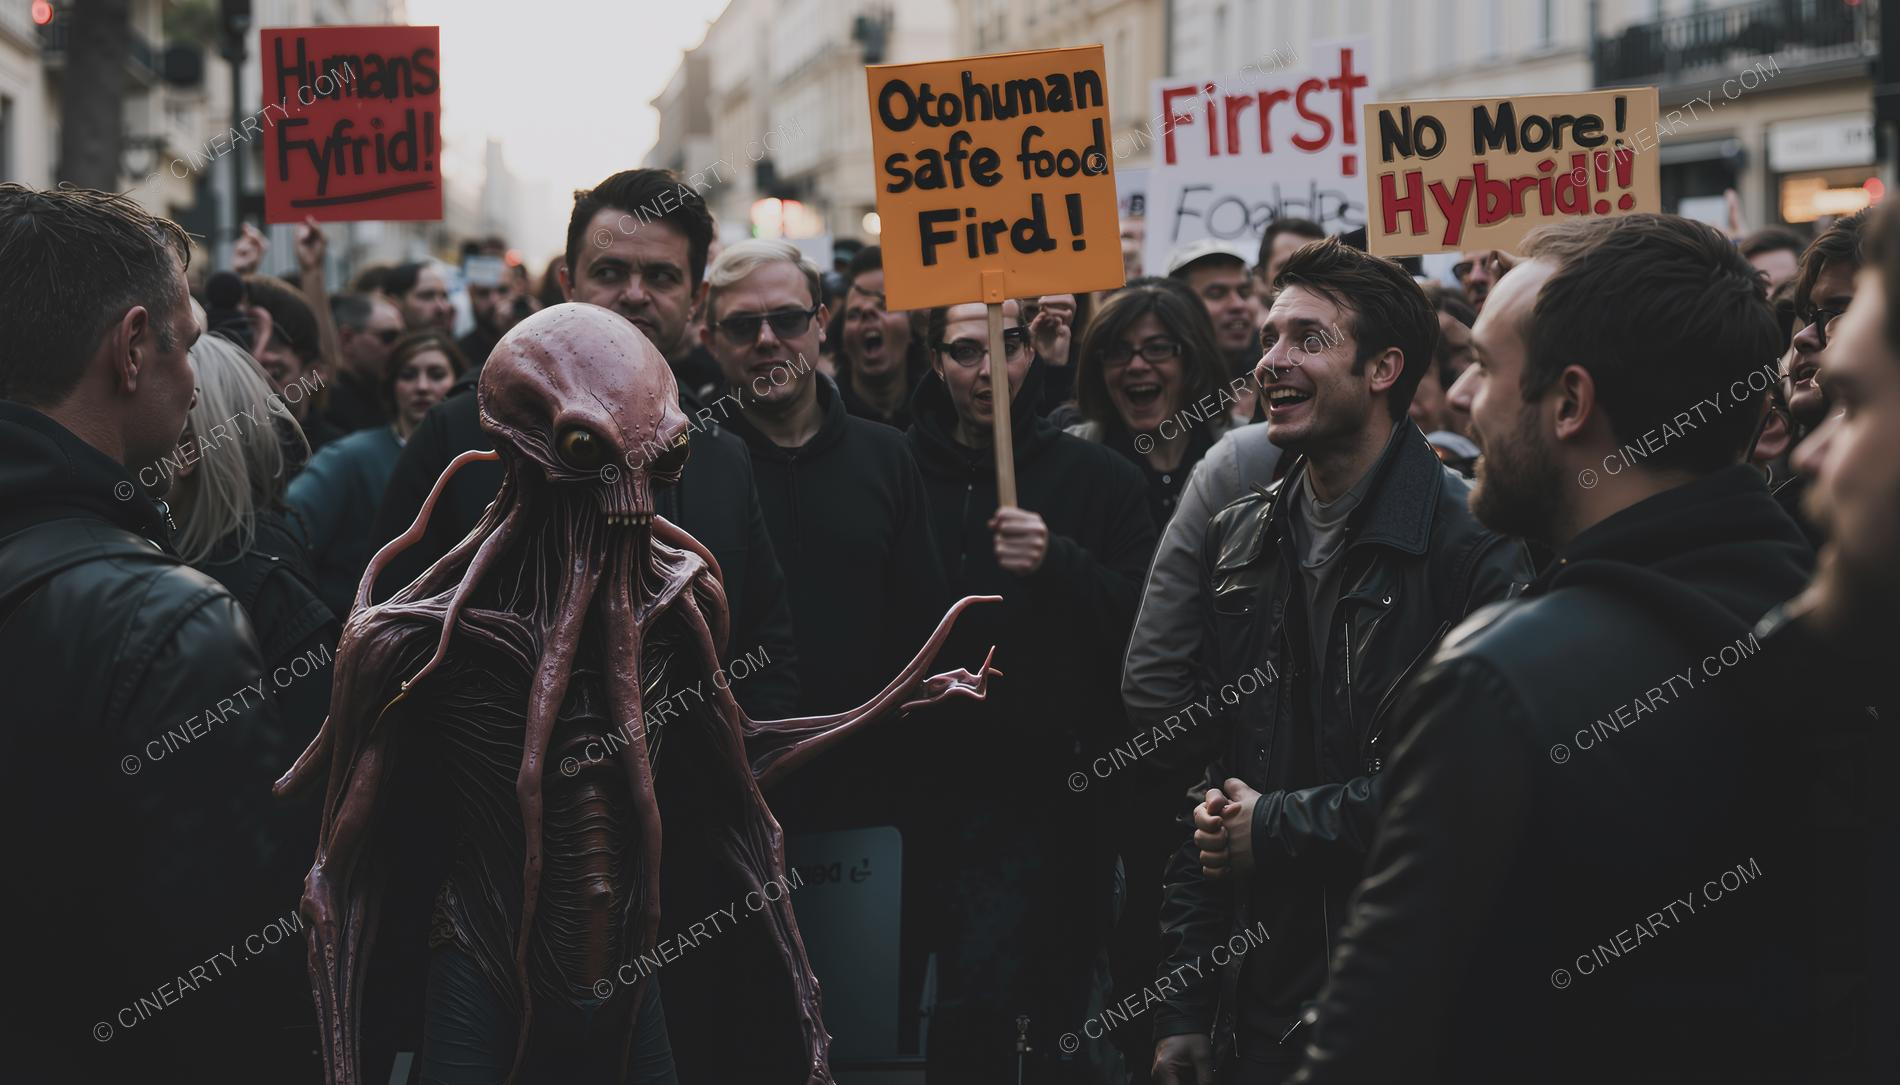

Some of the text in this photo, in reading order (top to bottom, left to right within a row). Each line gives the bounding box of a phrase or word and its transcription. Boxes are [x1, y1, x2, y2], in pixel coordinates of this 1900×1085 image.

[275, 37, 440, 105] Humans
[878, 70, 1104, 132] Otohuman
[277, 108, 434, 196] Fyfrid!
[884, 118, 1109, 193] safe food
[1378, 105, 1447, 163] No
[1380, 149, 1636, 246] Hybrid!!
